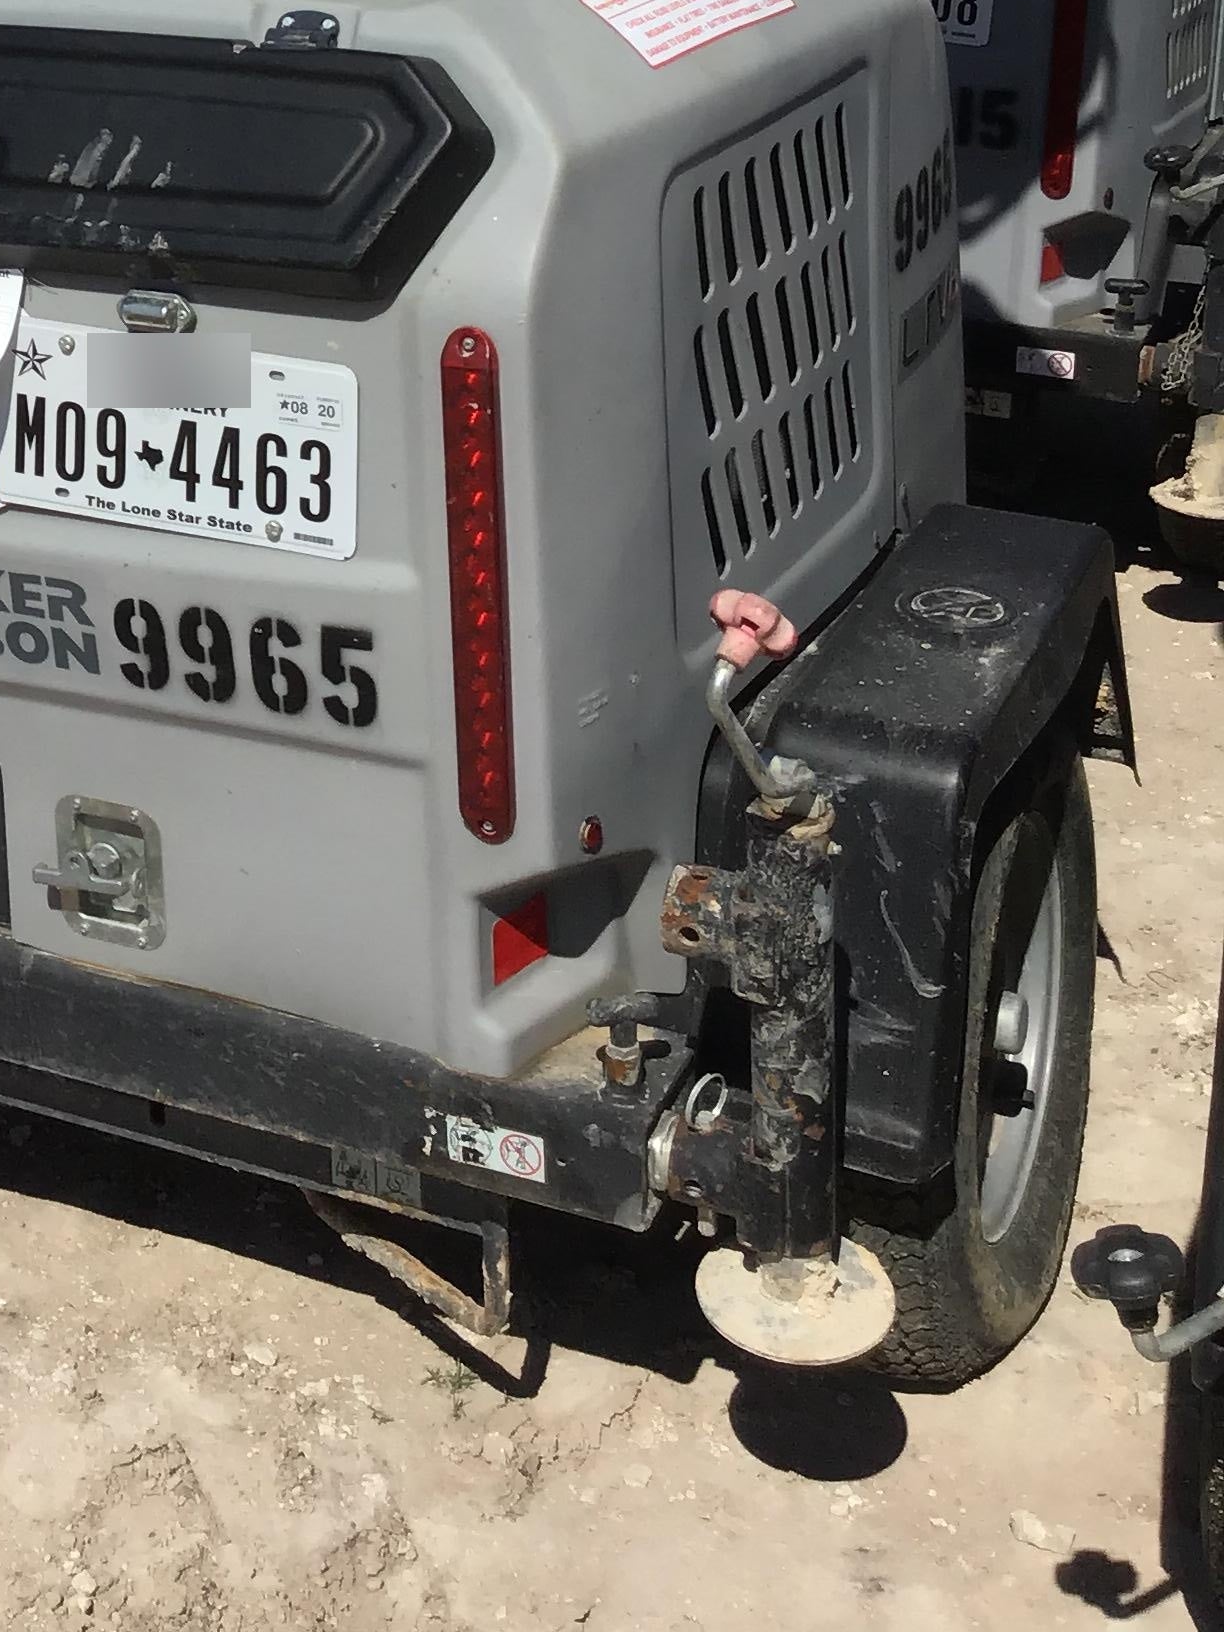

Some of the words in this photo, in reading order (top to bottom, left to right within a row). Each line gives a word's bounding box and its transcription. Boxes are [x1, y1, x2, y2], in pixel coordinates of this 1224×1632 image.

[318, 404, 336, 419] 20
[85, 494, 116, 511] The
[121, 500, 162, 519] Lone
[166, 508, 203, 526] Star
[206, 515, 254, 534] State
[113, 597, 378, 728] 9965
